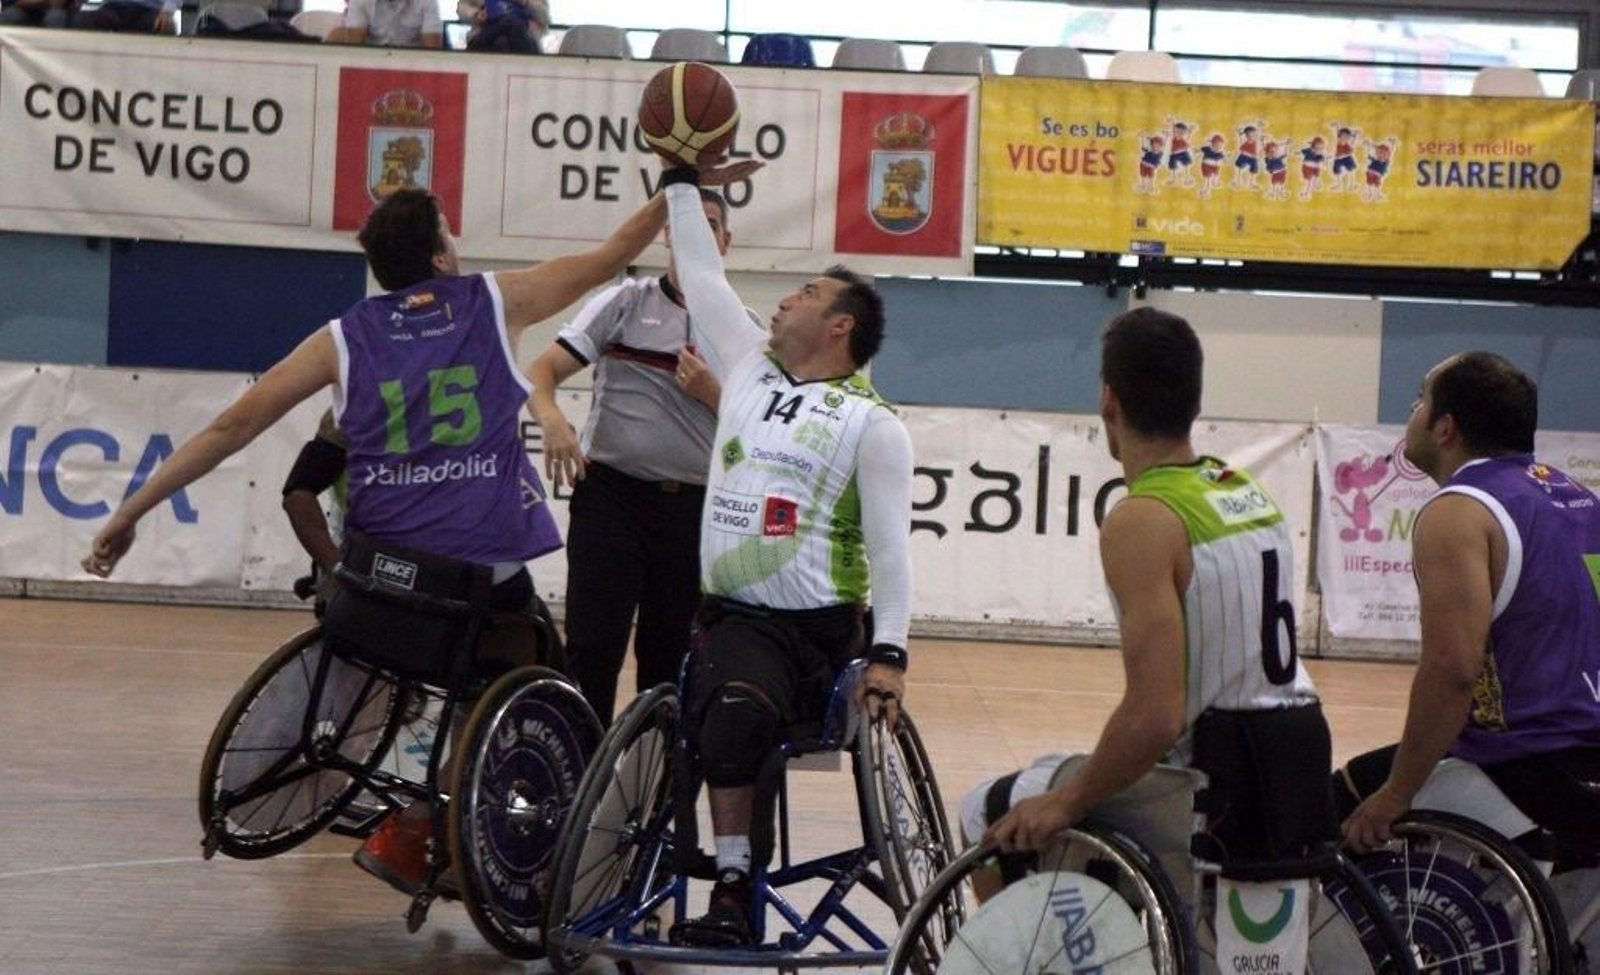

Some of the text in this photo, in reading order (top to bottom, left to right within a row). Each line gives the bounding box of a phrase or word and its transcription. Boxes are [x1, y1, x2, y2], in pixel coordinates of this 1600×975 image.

[24, 82, 284, 135] CONCELLO
[1042, 117, 1119, 138] Se es bo
[531, 111, 786, 161] CONLO
[1473, 140, 1536, 157] mellor
[53, 135, 251, 184] DE VIGO
[1006, 138, 1117, 177] VIGUÉS
[1416, 159, 1562, 190] SIAREIRO
[560, 164, 753, 208] DE VO
[379, 365, 483, 455] 15
[762, 390, 805, 425] 14
[364, 453, 498, 486] Valladolid
